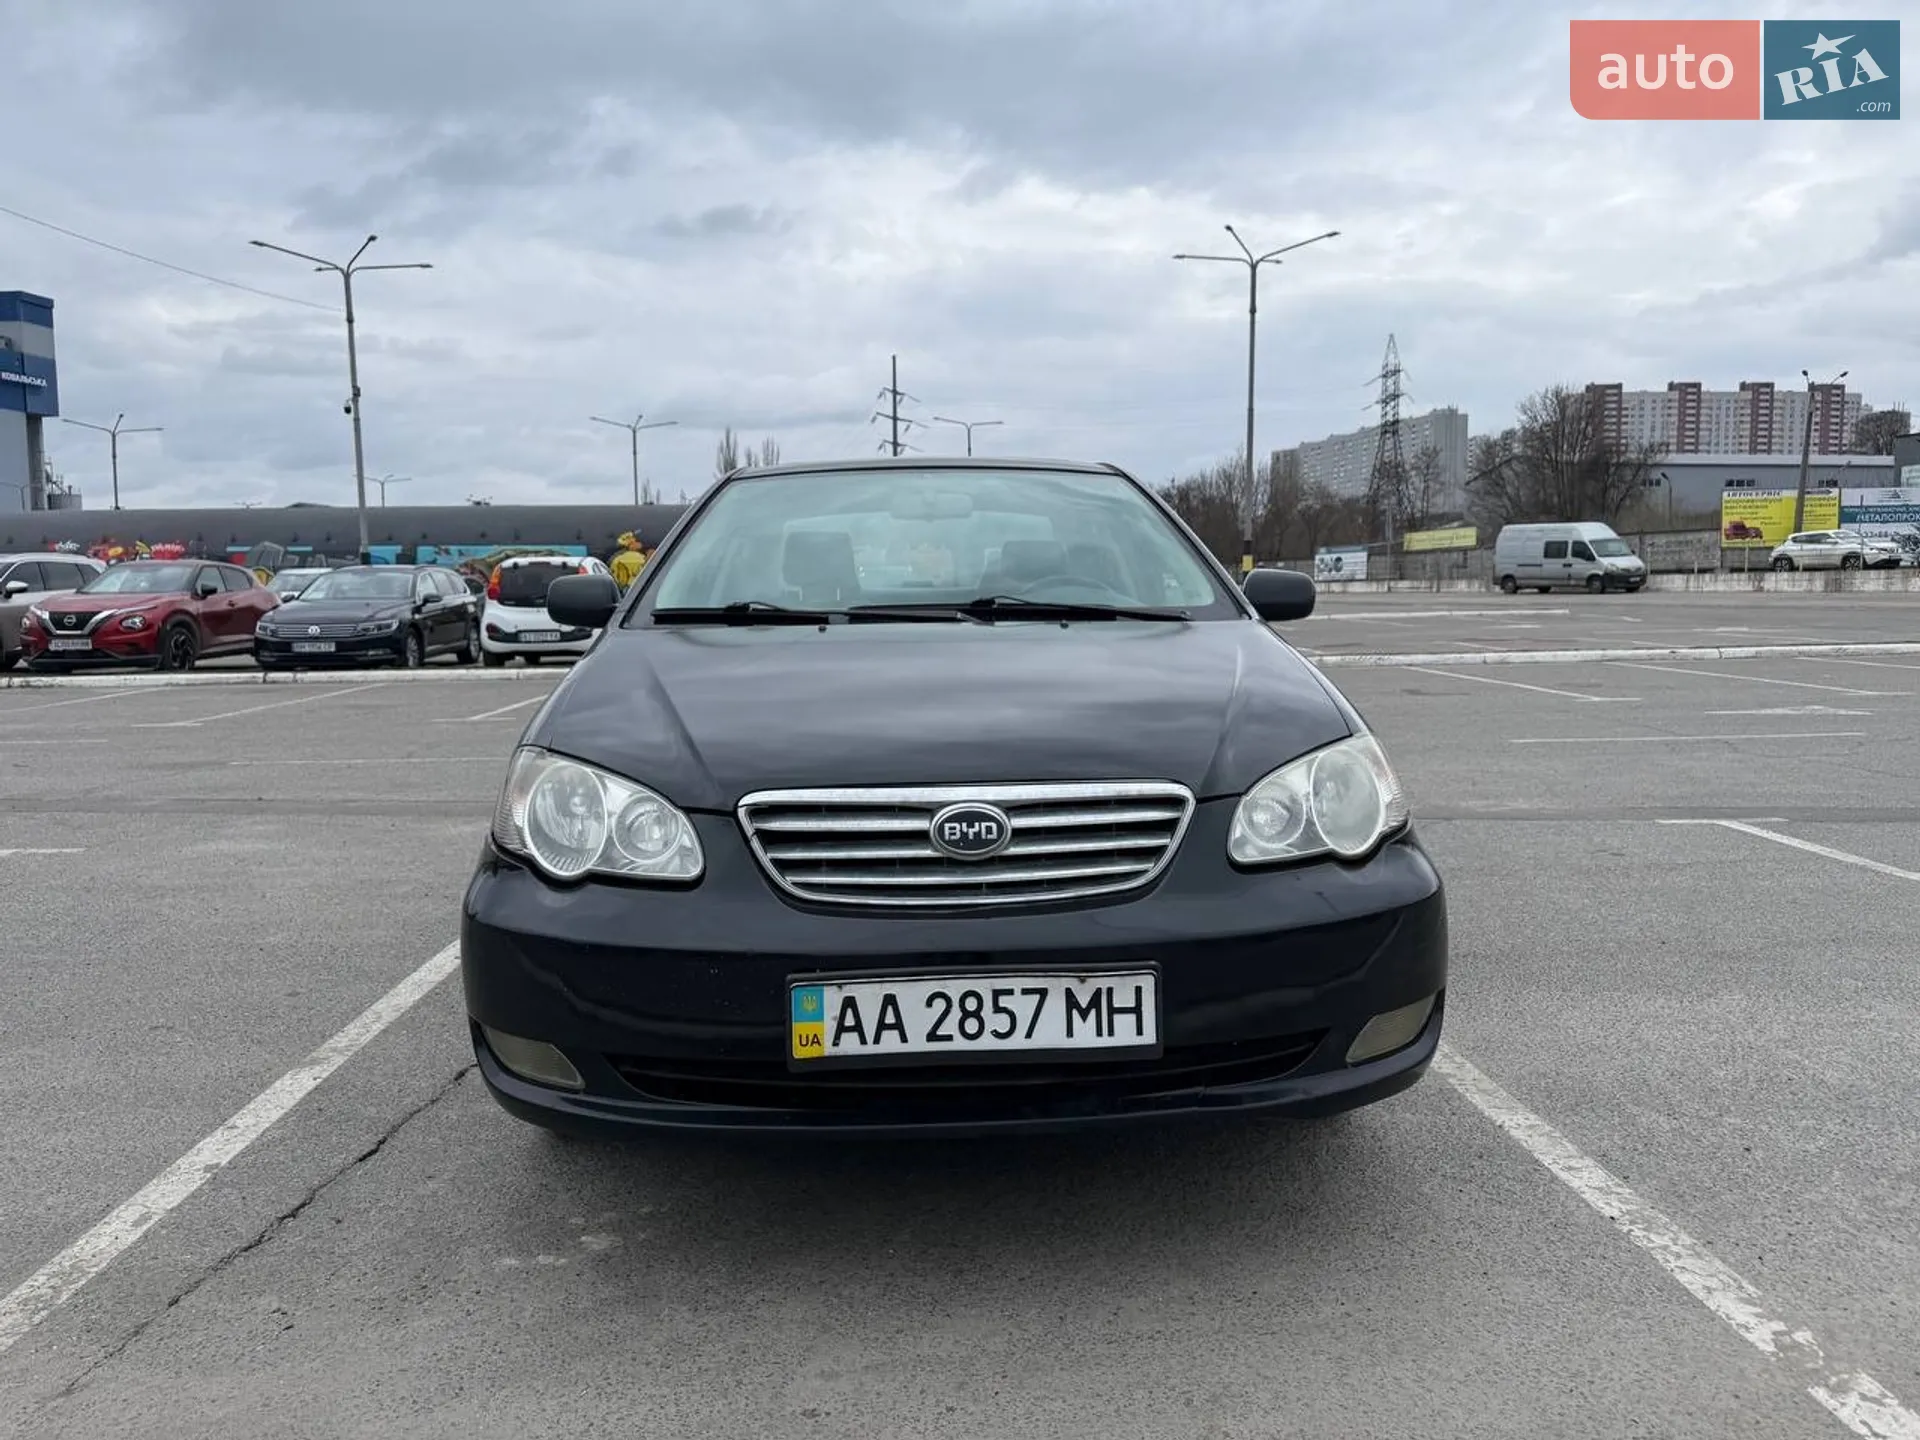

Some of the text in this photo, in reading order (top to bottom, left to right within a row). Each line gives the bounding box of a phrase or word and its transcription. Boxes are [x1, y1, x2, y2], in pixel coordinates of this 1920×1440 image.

[944, 821, 998, 841] BYD
[832, 985, 1144, 1047] AA 2857 MH
[798, 1033, 822, 1047] UA
